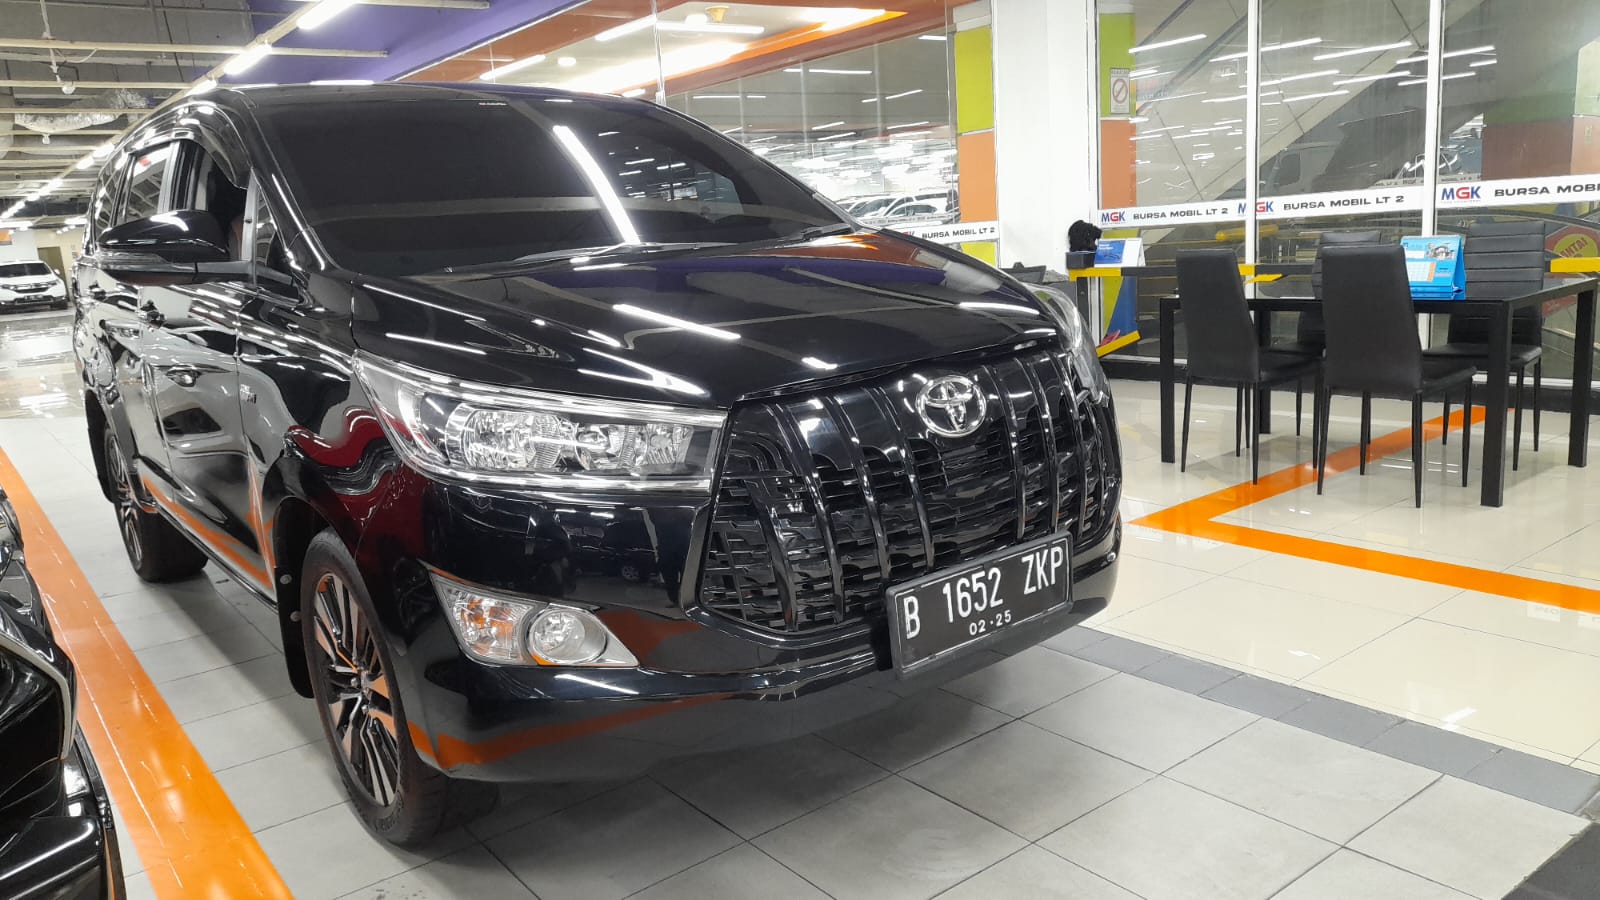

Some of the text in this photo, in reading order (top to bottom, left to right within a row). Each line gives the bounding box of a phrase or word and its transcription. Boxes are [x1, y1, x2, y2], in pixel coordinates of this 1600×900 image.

[1441, 186, 1481, 200] MGK
[1494, 187, 1550, 197] BURSA
[1283, 201, 1325, 211] BURSA
[1330, 198, 1371, 208] MOBIL
[1375, 196, 1391, 205] LT
[1395, 195, 1405, 203] 2
[1101, 211, 1126, 222] MGK
[1133, 212, 1167, 220] BURSA
[1170, 209, 1202, 217] MOBIL
[922, 231, 950, 240] BURSA
[903, 546, 1064, 640] B 1652 ZKP
